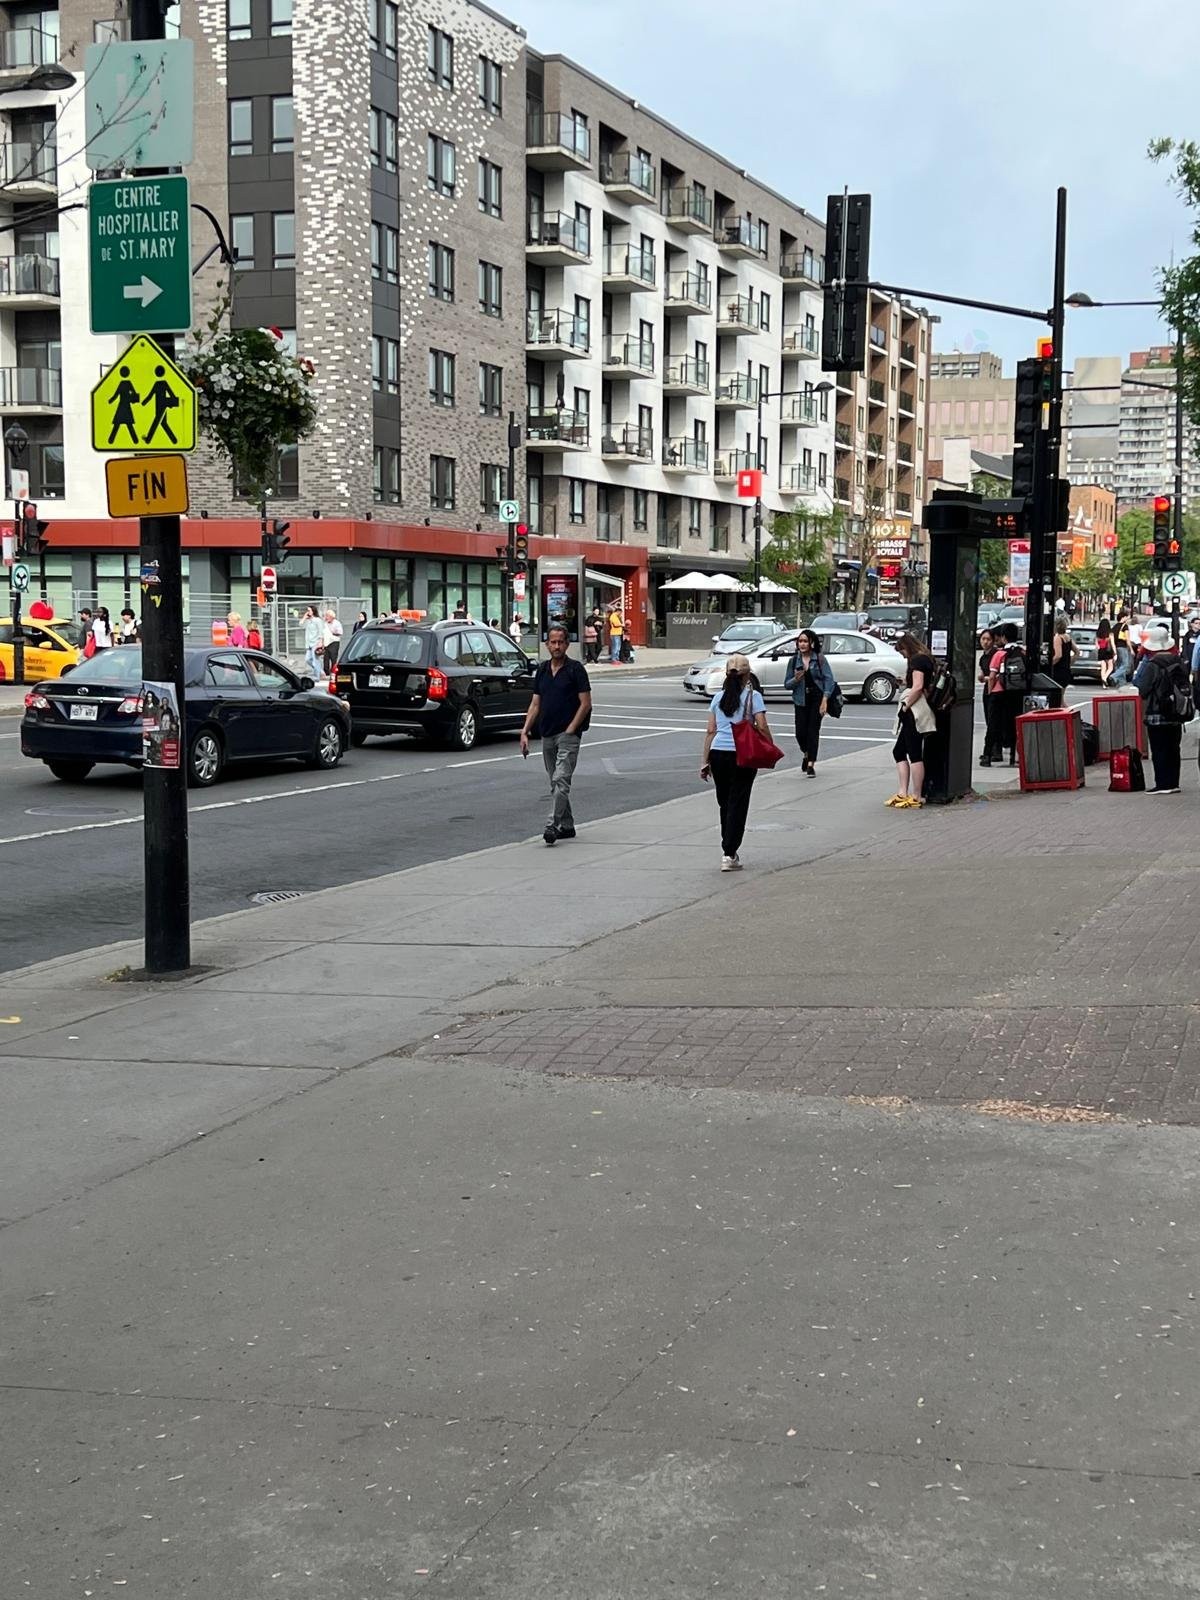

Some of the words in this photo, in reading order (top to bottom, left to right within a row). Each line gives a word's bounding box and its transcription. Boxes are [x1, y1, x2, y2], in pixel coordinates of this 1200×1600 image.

[115, 185, 161, 208] CENTRE
[98, 210, 179, 235] HOSPITALIER
[101, 247, 112, 261] DE
[120, 237, 176, 260] ST.MARY
[128, 472, 166, 501] FIN
